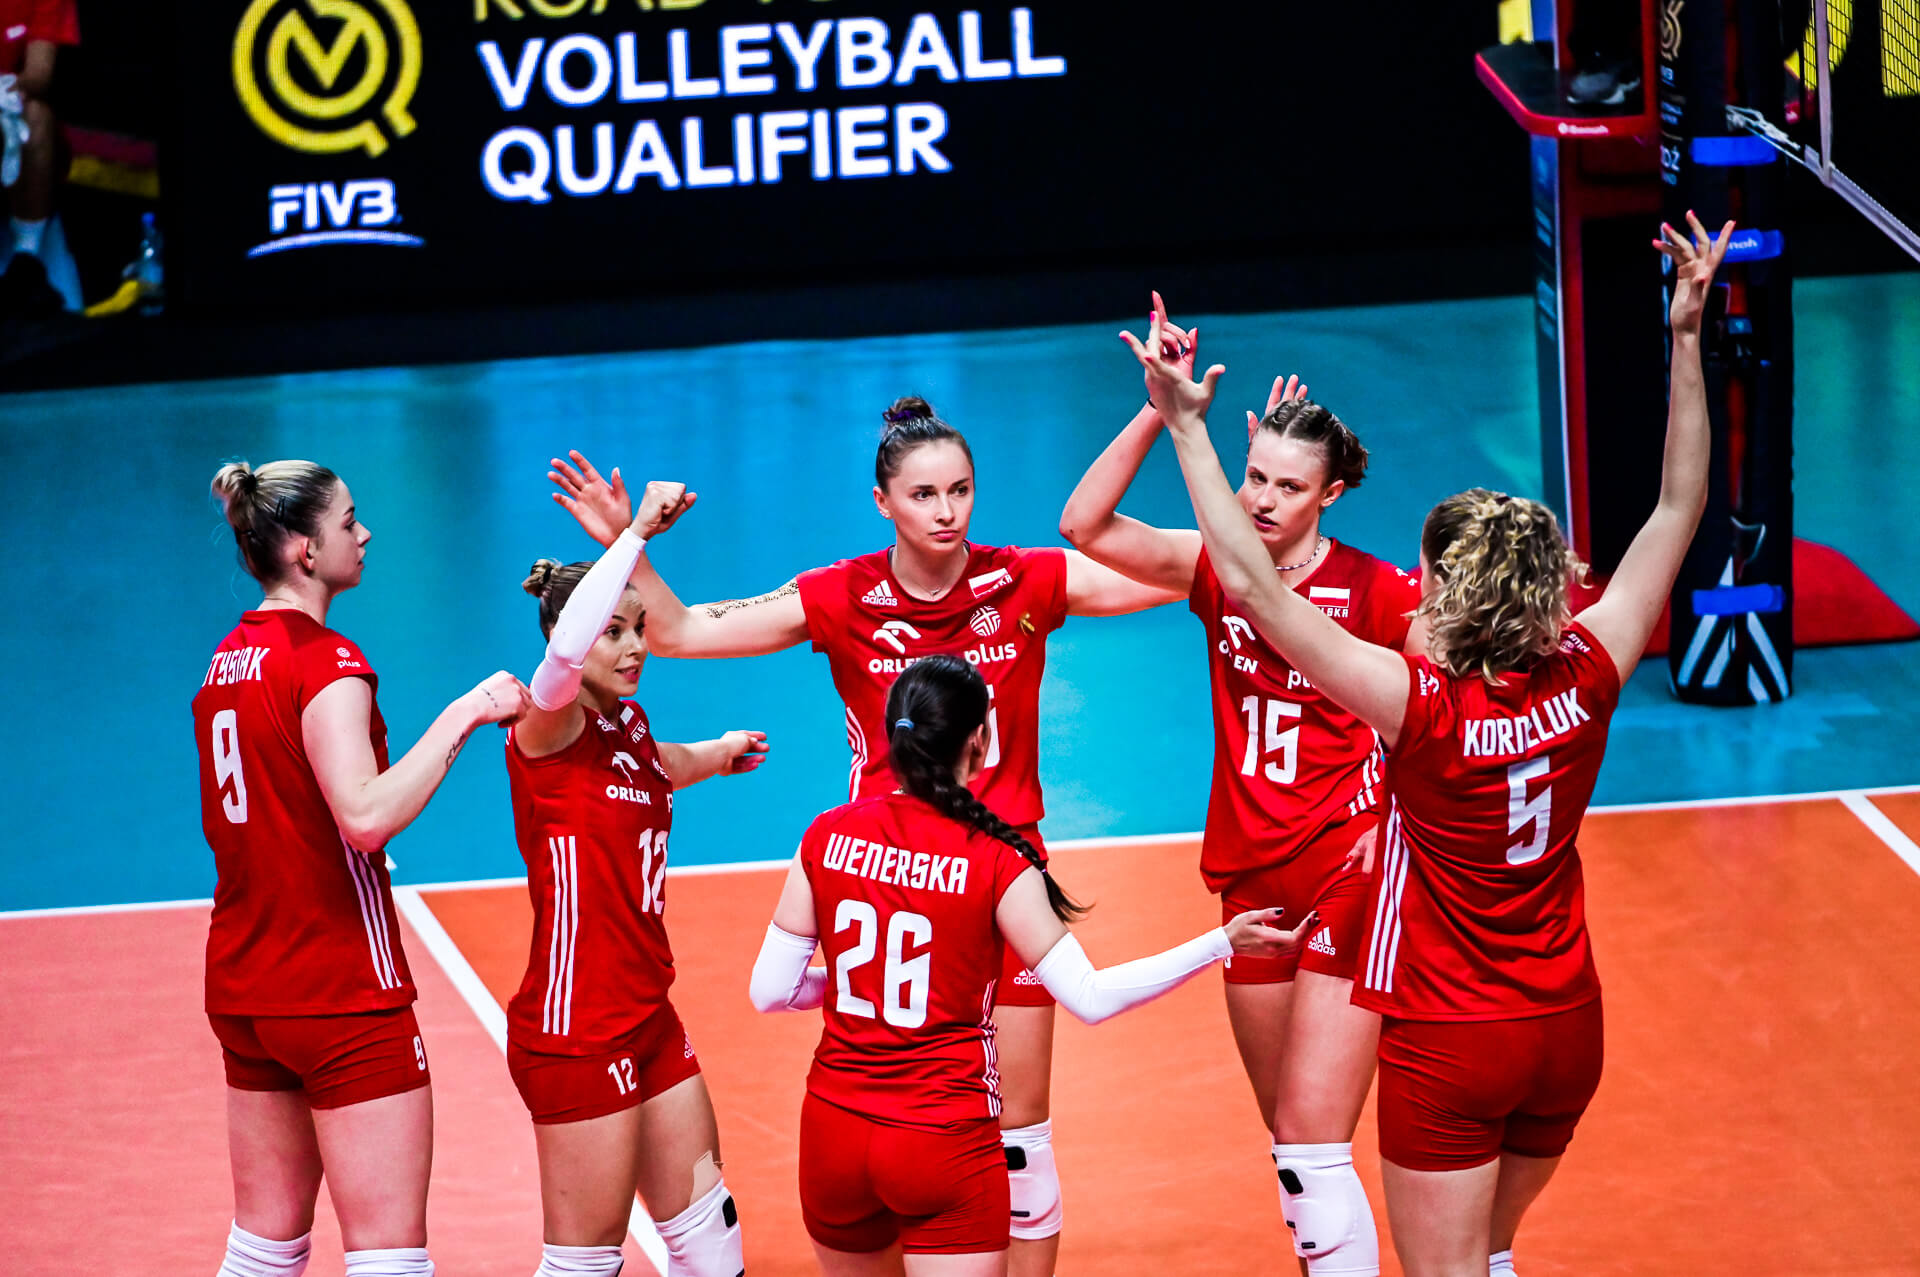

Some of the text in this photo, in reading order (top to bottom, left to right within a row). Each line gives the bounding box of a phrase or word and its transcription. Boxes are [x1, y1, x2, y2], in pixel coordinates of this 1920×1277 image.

[477, 8, 1067, 110] VOLLEYBALL
[480, 103, 953, 204] QUALIFIER
[270, 177, 397, 234] FIVB
[861, 590, 898, 607] adidas
[202, 646, 271, 688] TYSIAK
[337, 658, 361, 669] plus
[868, 657, 922, 674] ORLE
[963, 641, 1018, 667] plus
[1218, 639, 1259, 675] OEN
[1241, 694, 1302, 785] 15
[212, 708, 248, 824] 9
[605, 784, 652, 805] ORLEN
[1505, 755, 1552, 866] 5
[638, 827, 669, 915] 12
[822, 832, 969, 895] WENERSKA
[834, 898, 933, 1029] 26
[413, 1035, 426, 1071] 9
[607, 1057, 638, 1095] 12
